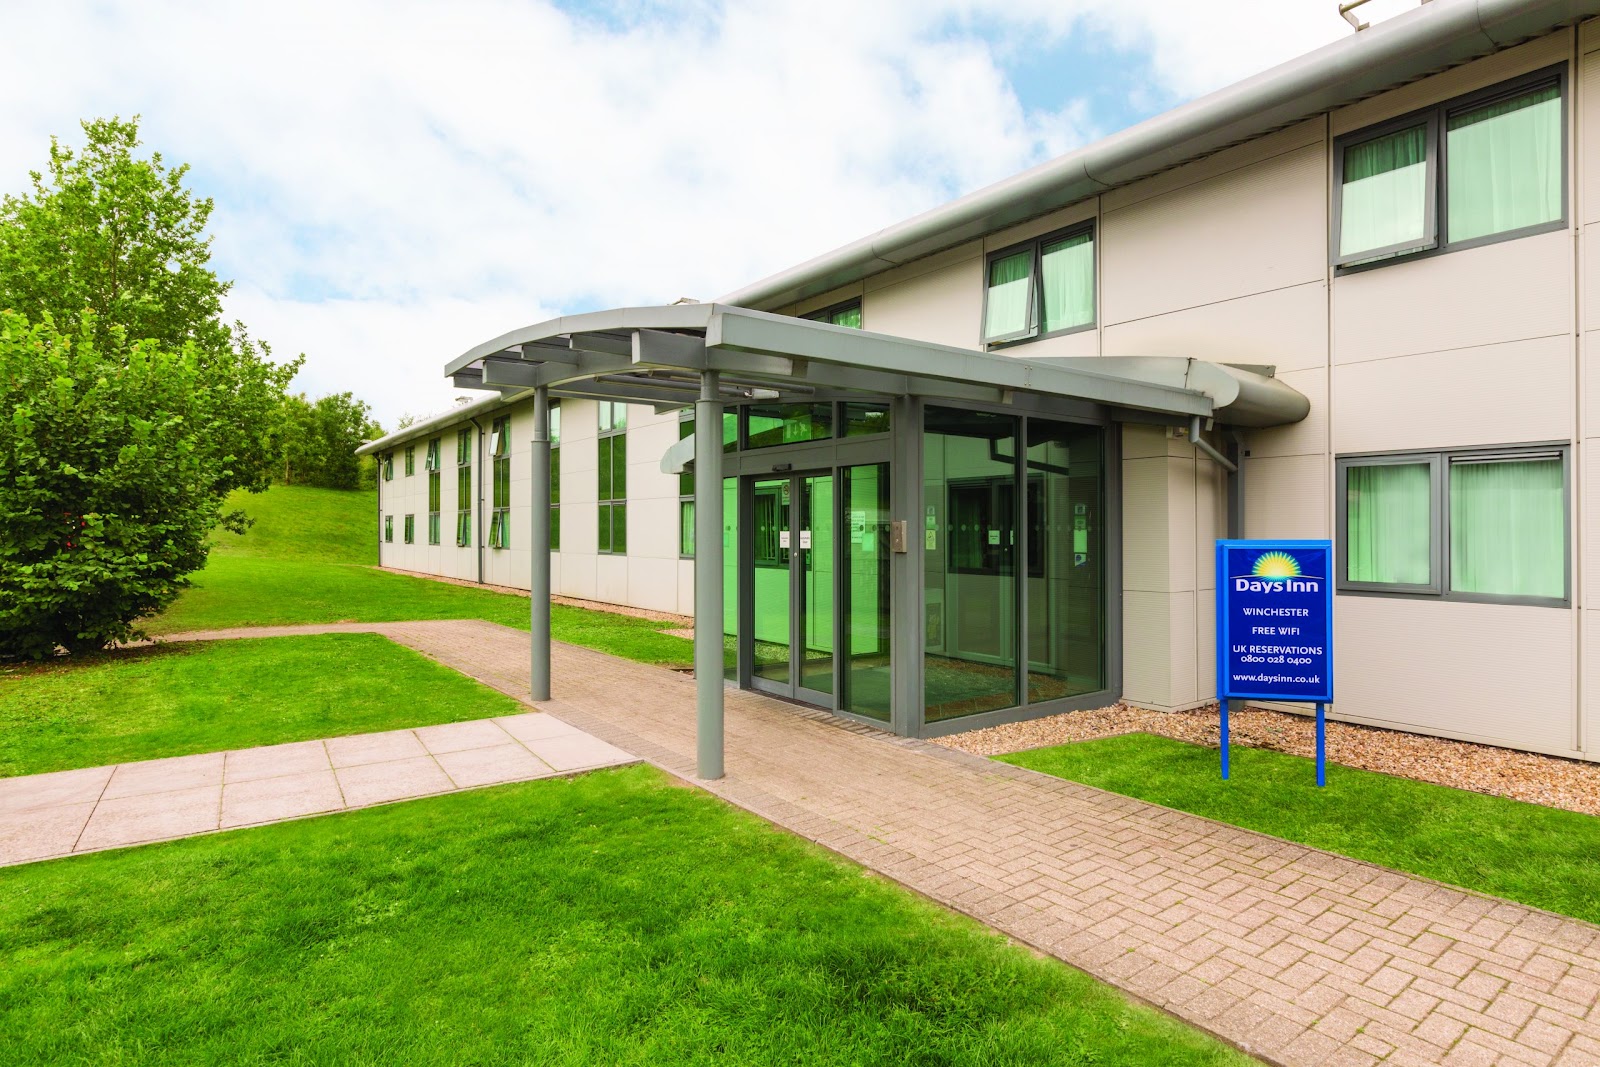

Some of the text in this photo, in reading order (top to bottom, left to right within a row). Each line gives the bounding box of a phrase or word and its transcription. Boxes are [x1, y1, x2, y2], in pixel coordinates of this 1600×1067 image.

[1236, 578, 1318, 594] Days Inn
[1243, 608, 1308, 616] WINCHESTER
[1252, 626, 1300, 636] FREE WIFI
[1233, 644, 1322, 655] UK RESERVATIONS
[1240, 654, 1312, 666] 0800 028 0400
[1233, 673, 1320, 684] www.daysinn.co.uk
